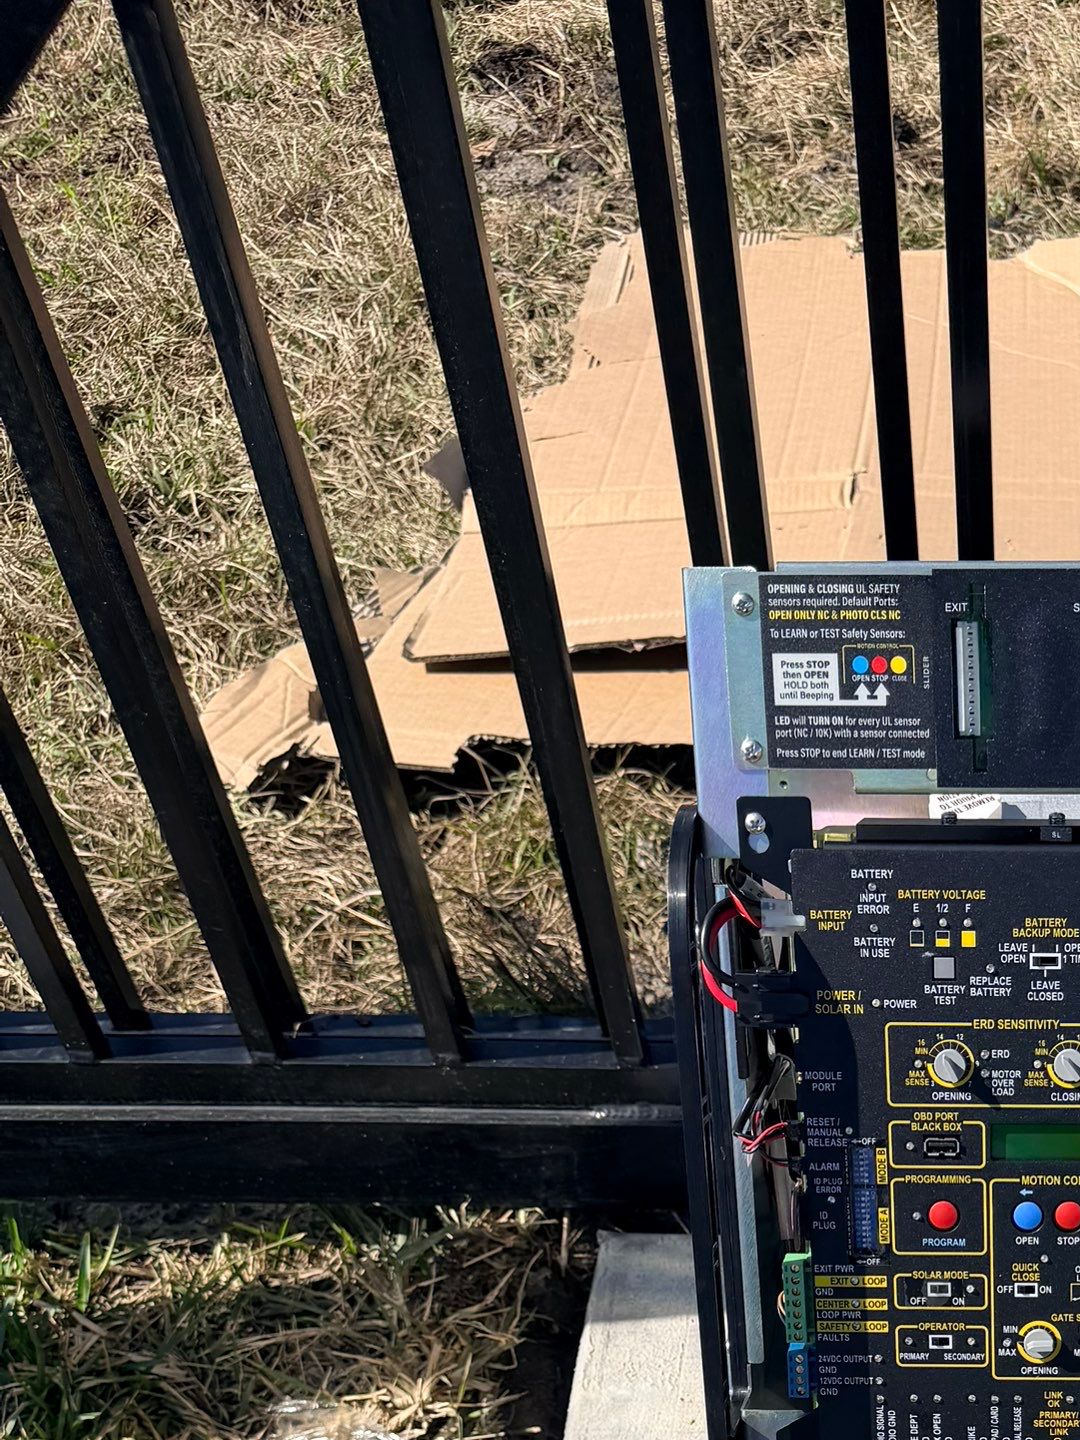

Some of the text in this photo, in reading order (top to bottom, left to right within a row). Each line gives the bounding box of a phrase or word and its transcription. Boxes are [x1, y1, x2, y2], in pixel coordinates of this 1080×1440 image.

[768, 584, 900, 594] OPENING & CLOSING UL SAFETY
[768, 598, 800, 606] sensors
[842, 596, 872, 606] Default
[874, 596, 898, 606] Ports:
[945, 602, 968, 612] EXIT
[768, 610, 900, 620] OPEN ONLY NC & PHOTO CLS NC
[770, 629, 778, 638] To
[780, 629, 808, 638] LEARN
[820, 629, 840, 638] TEST
[842, 628, 868, 640] Safety
[870, 629, 905, 638] Sensors:
[780, 660, 830, 668] Press STOP
[784, 681, 829, 689] HOLD both
[780, 692, 834, 702] until Beeping
[851, 870, 894, 879] BATTERY
[860, 894, 886, 902] INPUT
[898, 890, 986, 900] BATTERY VOLTAGE
[857, 906, 890, 914] ERROR
[810, 910, 852, 920] BATTERY
[818, 922, 845, 931] INPUT
[1025, 918, 1067, 927] BATTERY
[1012, 929, 1080, 938] BACKUP MODE
[999, 943, 1028, 952] LEAVE
[1001, 955, 1026, 964] OPEN
[924, 985, 965, 994] BATTERY
[884, 1000, 917, 1008] POWER
[934, 996, 956, 1005] TEST
[973, 1020, 1060, 1029] ERD SENSITIVITY
[805, 1072, 842, 1080] MODULE
[992, 1070, 1021, 1078] MOTOR
[812, 1083, 836, 1092] PORT
[992, 1088, 1014, 1096] LOAD
[932, 1092, 972, 1101] OPENING
[914, 1112, 959, 1121] OBD PORT
[911, 1123, 962, 1131] BLACK BOX
[905, 1175, 971, 1184] PROGRAMMING
[1022, 1175, 1062, 1185] MOTION
[1016, 1237, 1039, 1245] OPEN
[1057, 1237, 1080, 1245] STOP
[1012, 1263, 1039, 1272] QUICK
[912, 1271, 969, 1279] SOLAR MODE
[1012, 1273, 1040, 1281] CLOSE
[919, 1323, 965, 1331] OPERATOR
[876, 1405, 885, 1430] SIGNAL
[910, 1414, 918, 1434] DEPT
